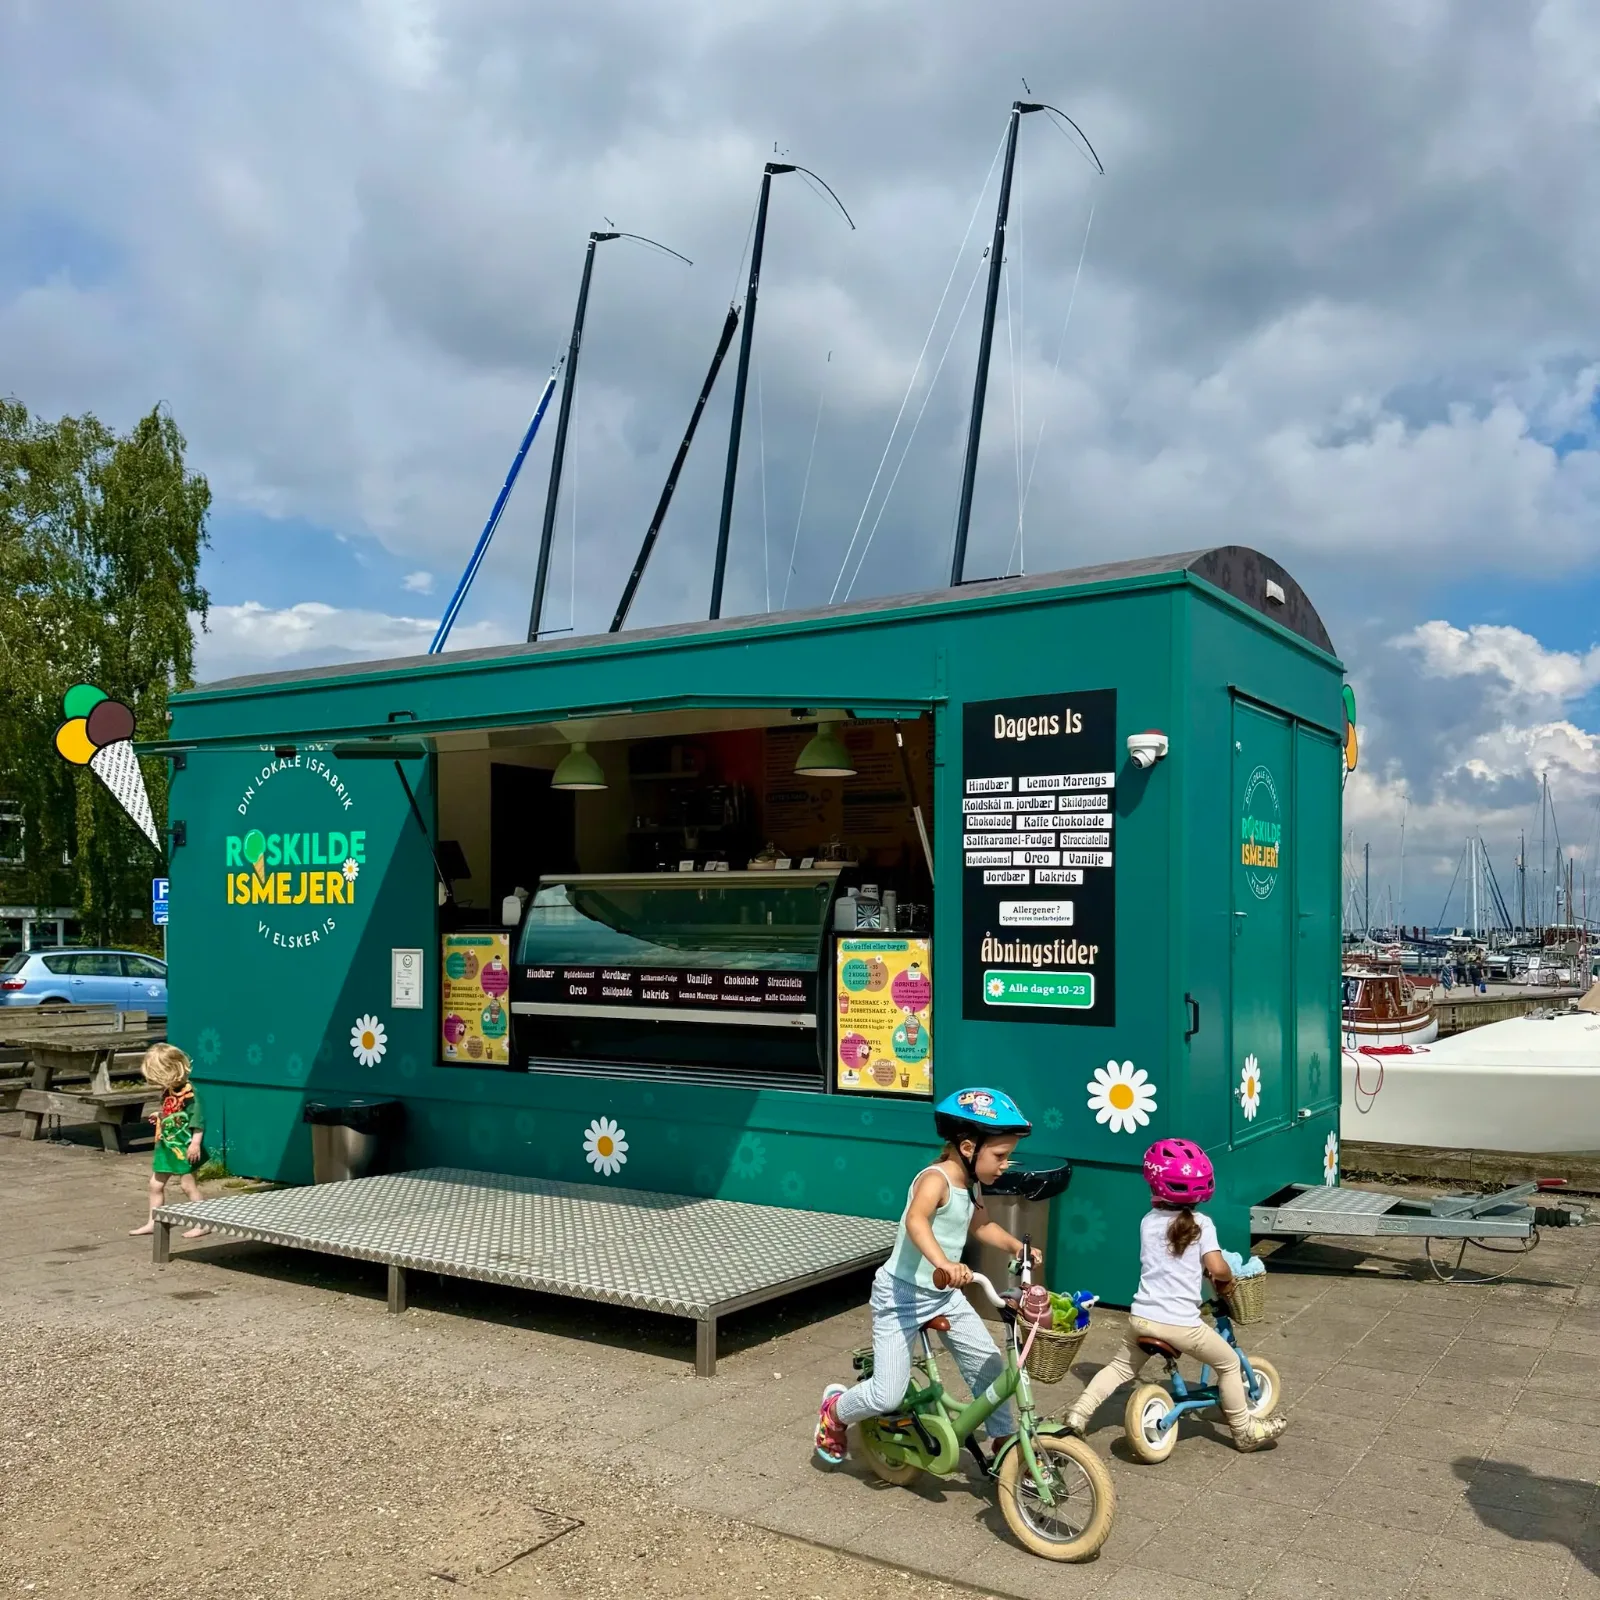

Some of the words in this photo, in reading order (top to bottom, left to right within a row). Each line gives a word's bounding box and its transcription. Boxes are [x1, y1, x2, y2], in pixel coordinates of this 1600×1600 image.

[995, 714, 1059, 741] Dagens
[1066, 708, 1082, 734] Is
[238, 789, 255, 815] DIN
[256, 755, 301, 787] LOKALE
[306, 757, 353, 811] ISFABRIK
[969, 779, 1009, 791] Hindbær
[1027, 778, 1060, 789] Lemon
[1063, 776, 1107, 787] Marengs
[964, 799, 1001, 810] Koldskål
[1003, 801, 1014, 809] m.
[1017, 799, 1052, 810] jordbær
[1062, 797, 1106, 808] Skildpadde
[969, 817, 1011, 826] Chokolade
[1024, 816, 1049, 827] Kaffe
[1052, 816, 1104, 827] Chokolade
[967, 835, 1053, 845] Saltkaramel-Fudge
[1062, 834, 1108, 845] Stracciatella
[967, 855, 1010, 864] Hyldeblomst
[1024, 853, 1049, 864] Oreo
[1069, 853, 1104, 865] Vanilje
[986, 872, 1025, 882] Jordbær
[1039, 872, 1077, 882] Lakrids
[258, 921, 269, 938] VI
[273, 931, 320, 948] ELSKER
[323, 918, 335, 934] IS
[981, 931, 1099, 967] Åbningstider
[527, 969, 555, 978] Hindbær
[602, 970, 631, 981] Jordbær
[687, 973, 712, 985] Vanilje
[724, 975, 759, 985] Chokolade
[768, 977, 802, 988] Stracciatella
[570, 985, 587, 995] Oreo
[602, 987, 633, 997] Skildpadde
[642, 989, 669, 1000] Lakrids
[1009, 984, 1028, 993] Alle
[1031, 984, 1055, 996] dage
[1057, 985, 1085, 995] 10-23
